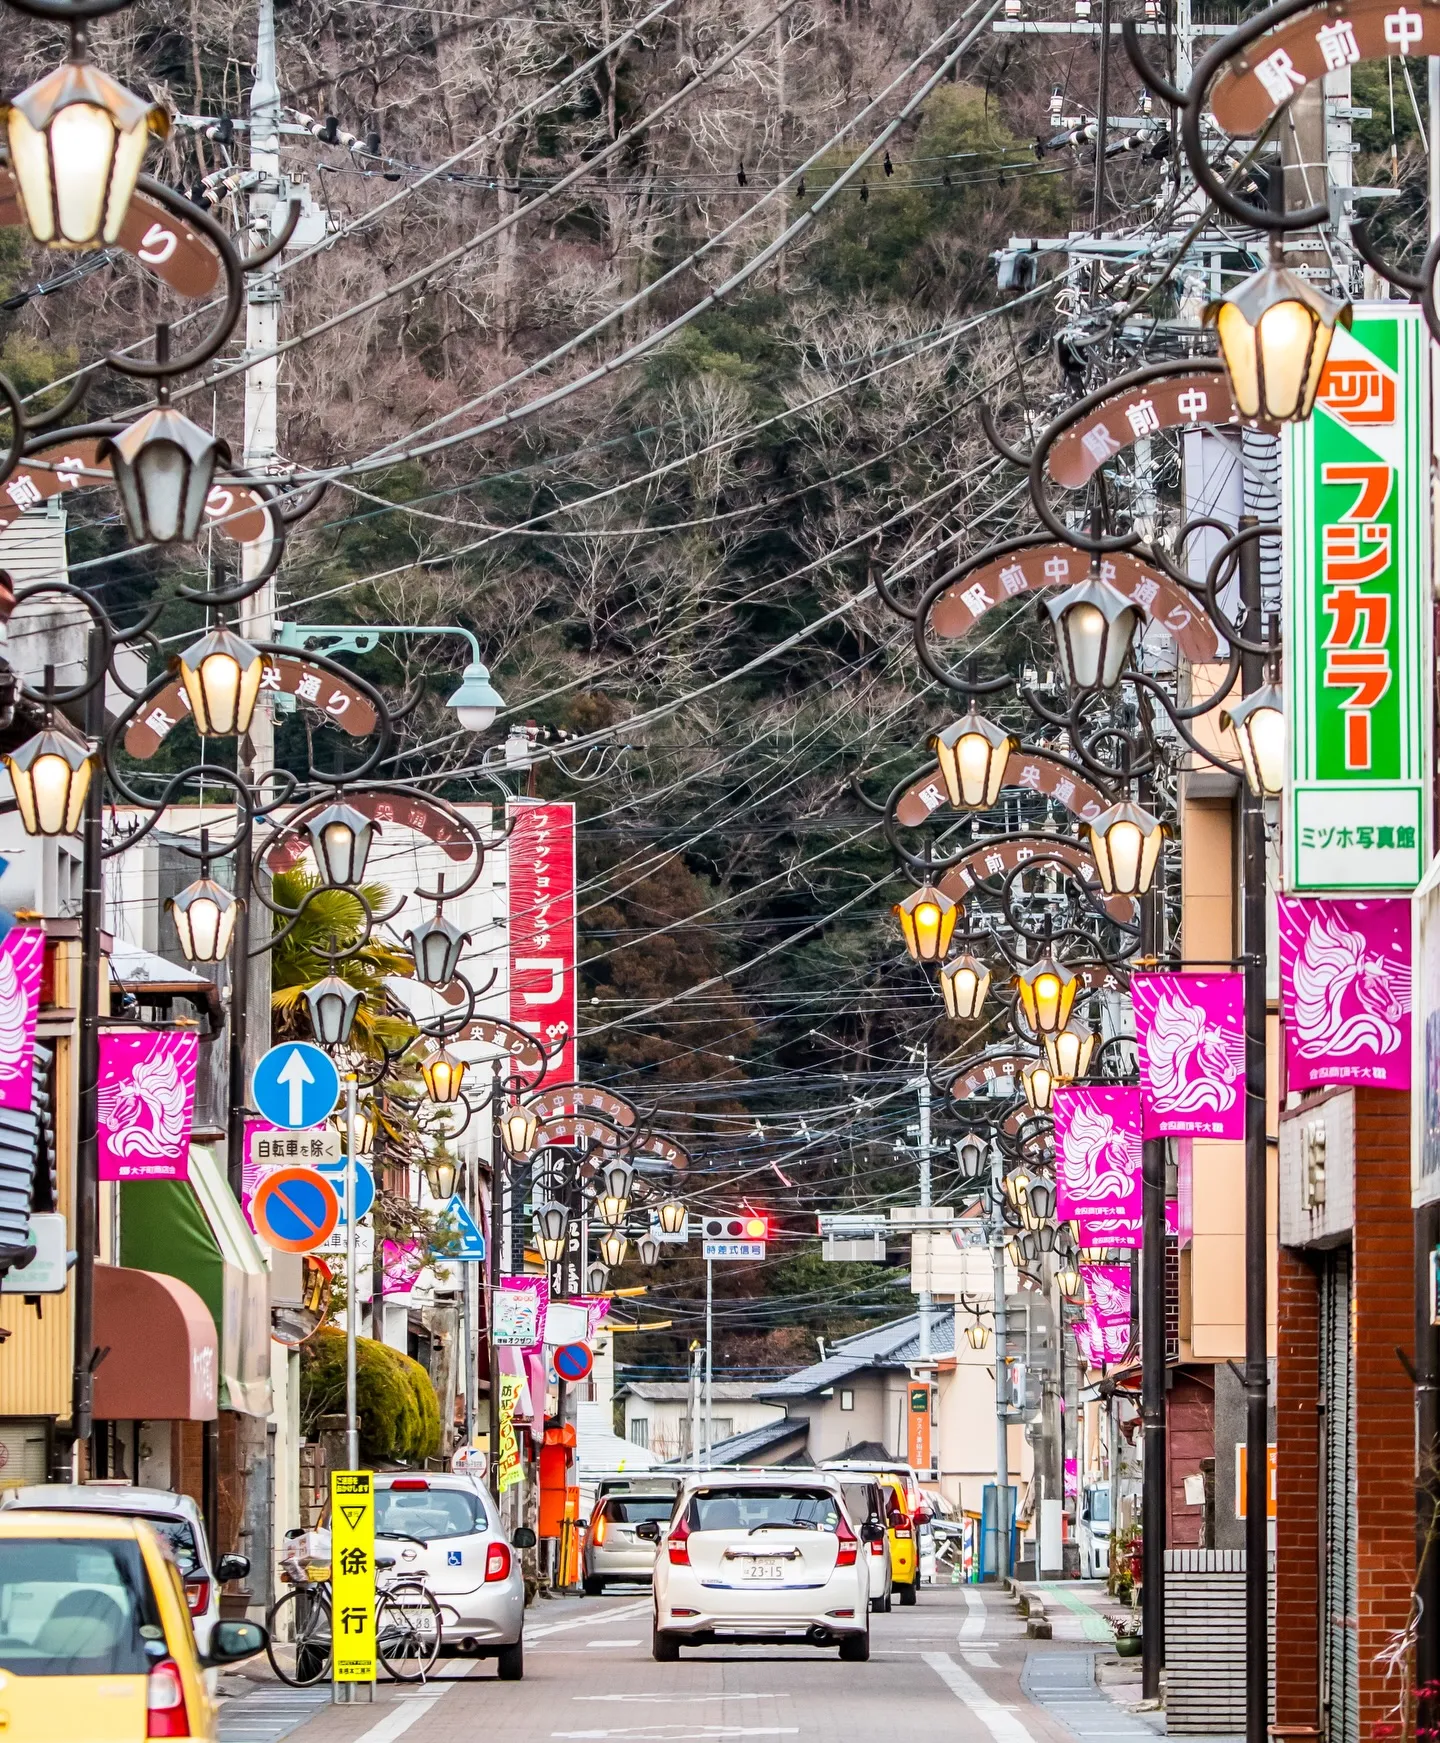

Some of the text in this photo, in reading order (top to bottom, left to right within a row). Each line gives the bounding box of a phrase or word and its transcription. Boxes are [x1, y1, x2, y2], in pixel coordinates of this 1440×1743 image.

[1321, 462, 1393, 771] フジカラー
[258, 1139, 335, 1157] 自転車を除く
[706, 1245, 761, 1255] 時差式信号
[340, 1547, 369, 1635] 徐行
